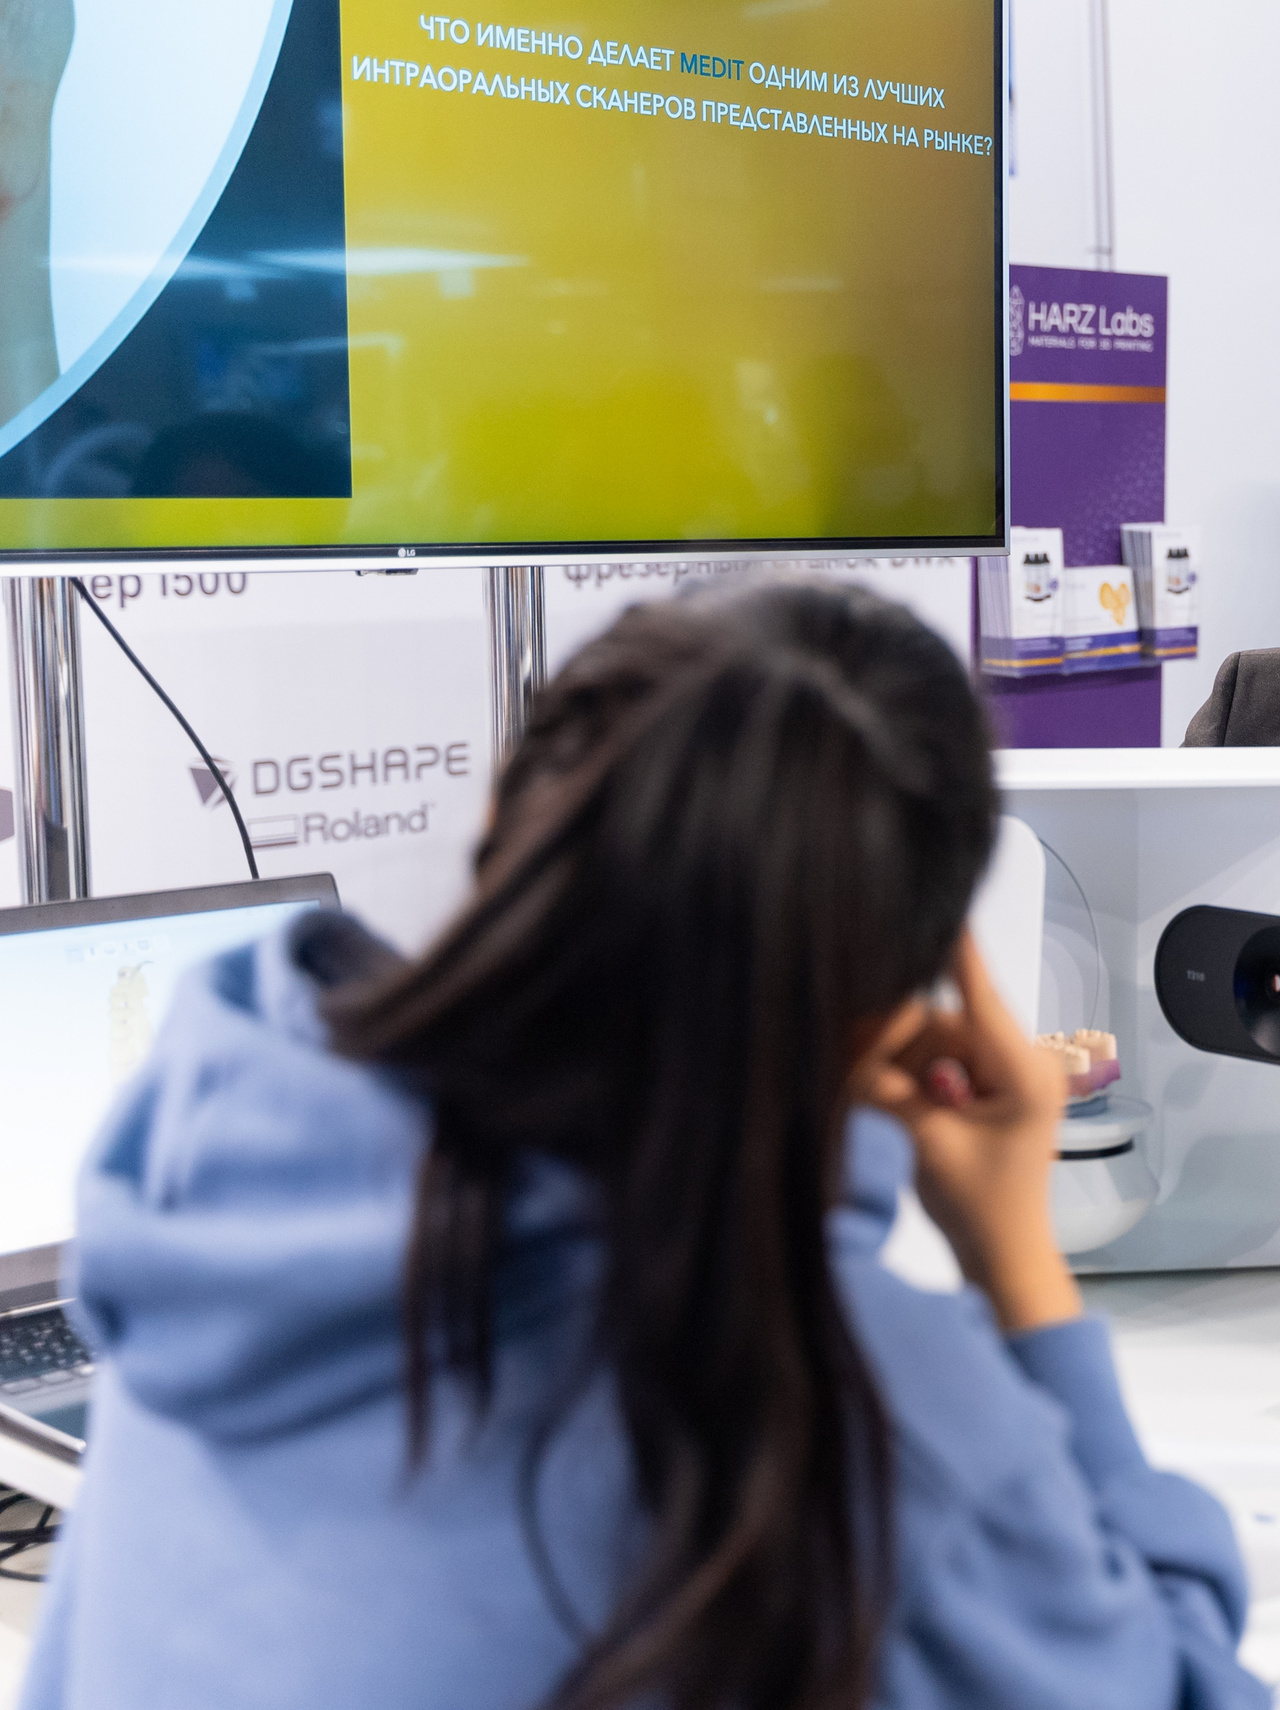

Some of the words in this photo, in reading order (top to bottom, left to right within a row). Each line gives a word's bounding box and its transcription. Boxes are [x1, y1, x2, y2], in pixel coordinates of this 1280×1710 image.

[419, 14, 471, 45] ЧТО
[477, 23, 584, 60] ИМЕННО
[587, 40, 675, 72] ДЕЛАЕТ
[680, 52, 745, 81] MEDIT
[748, 61, 828, 93] ОДНИМ
[833, 73, 859, 97] ИЗ
[863, 78, 946, 109] ЛУЧШИХ
[351, 55, 571, 106] ИНТРАОРАЛЬНЫХ
[575, 84, 696, 121] СКАНЕРОВ
[701, 99, 889, 144] ПРЕДСТАВЛЕННЫХ
[892, 124, 920, 148] НА
[923, 128, 994, 156] РЫНКЕ?
[1028, 301, 1096, 334] HARZ
[1098, 305, 1155, 338] Labs
[406, 549, 416, 557] LG
[252, 743, 470, 796] DGSHAPE
[303, 802, 428, 844] Roland
